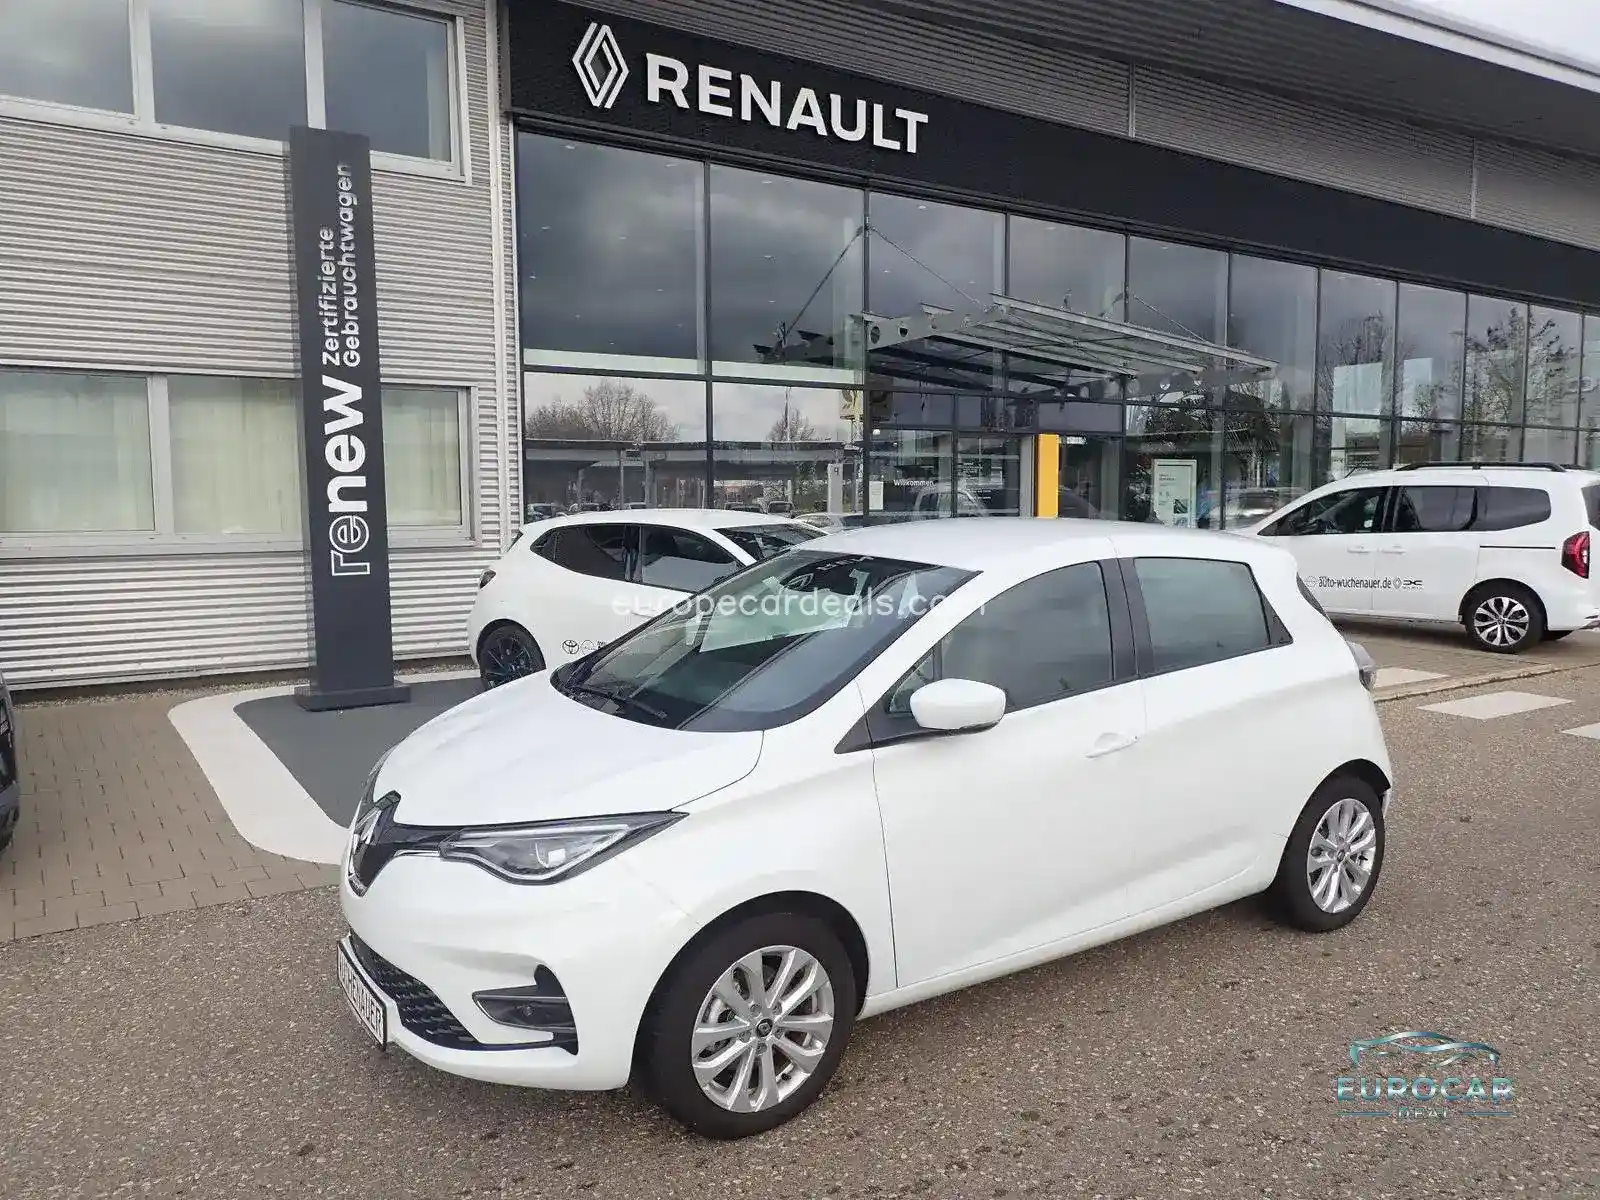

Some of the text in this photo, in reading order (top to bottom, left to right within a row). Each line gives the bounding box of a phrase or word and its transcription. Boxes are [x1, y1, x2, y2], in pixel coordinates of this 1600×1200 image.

[646, 53, 929, 153] RENAULT
[318, 227, 340, 366] Zertifizierte
[336, 163, 362, 368] Gebrauchtwagen
[322, 375, 371, 576] renew
[1318, 577, 1392, 589] auto-wuchenauer.de
